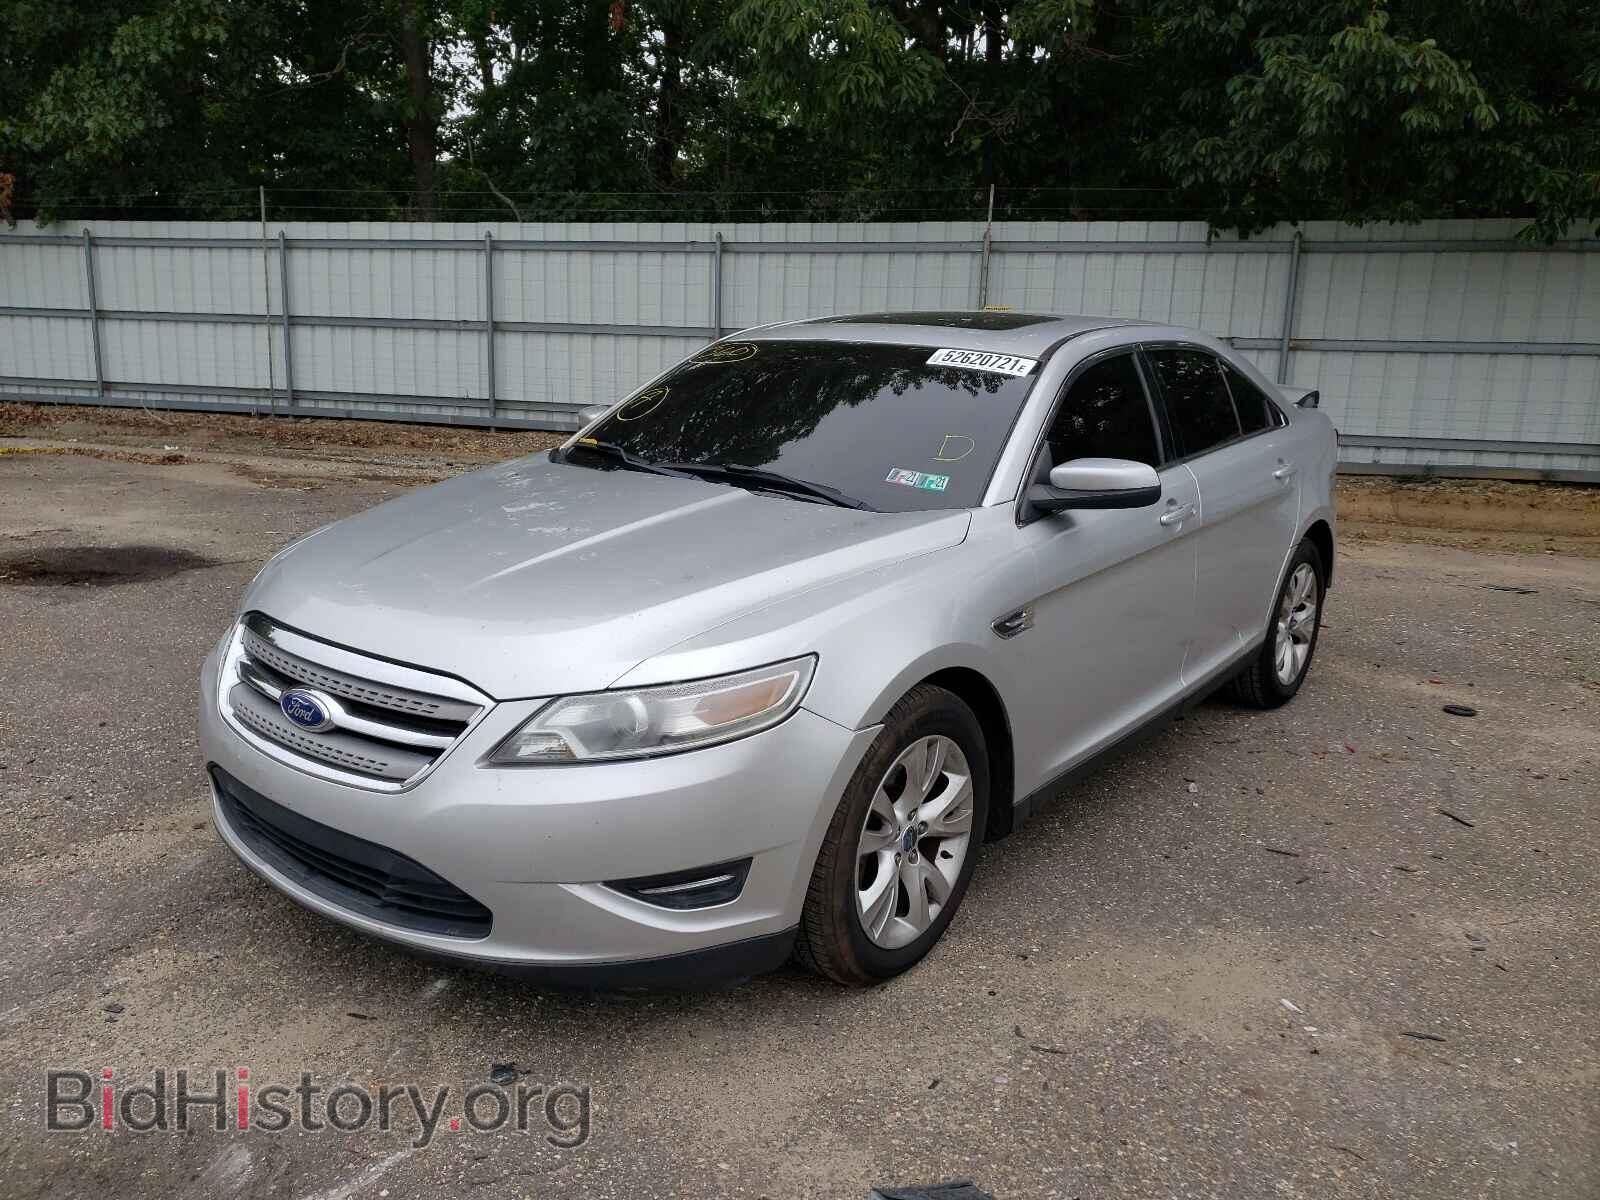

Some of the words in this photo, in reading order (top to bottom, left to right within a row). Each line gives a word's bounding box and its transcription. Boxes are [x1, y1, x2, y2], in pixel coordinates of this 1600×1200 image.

[942, 350, 1020, 371] 52620721
[930, 434, 975, 461] D
[287, 697, 316, 721] Ford
